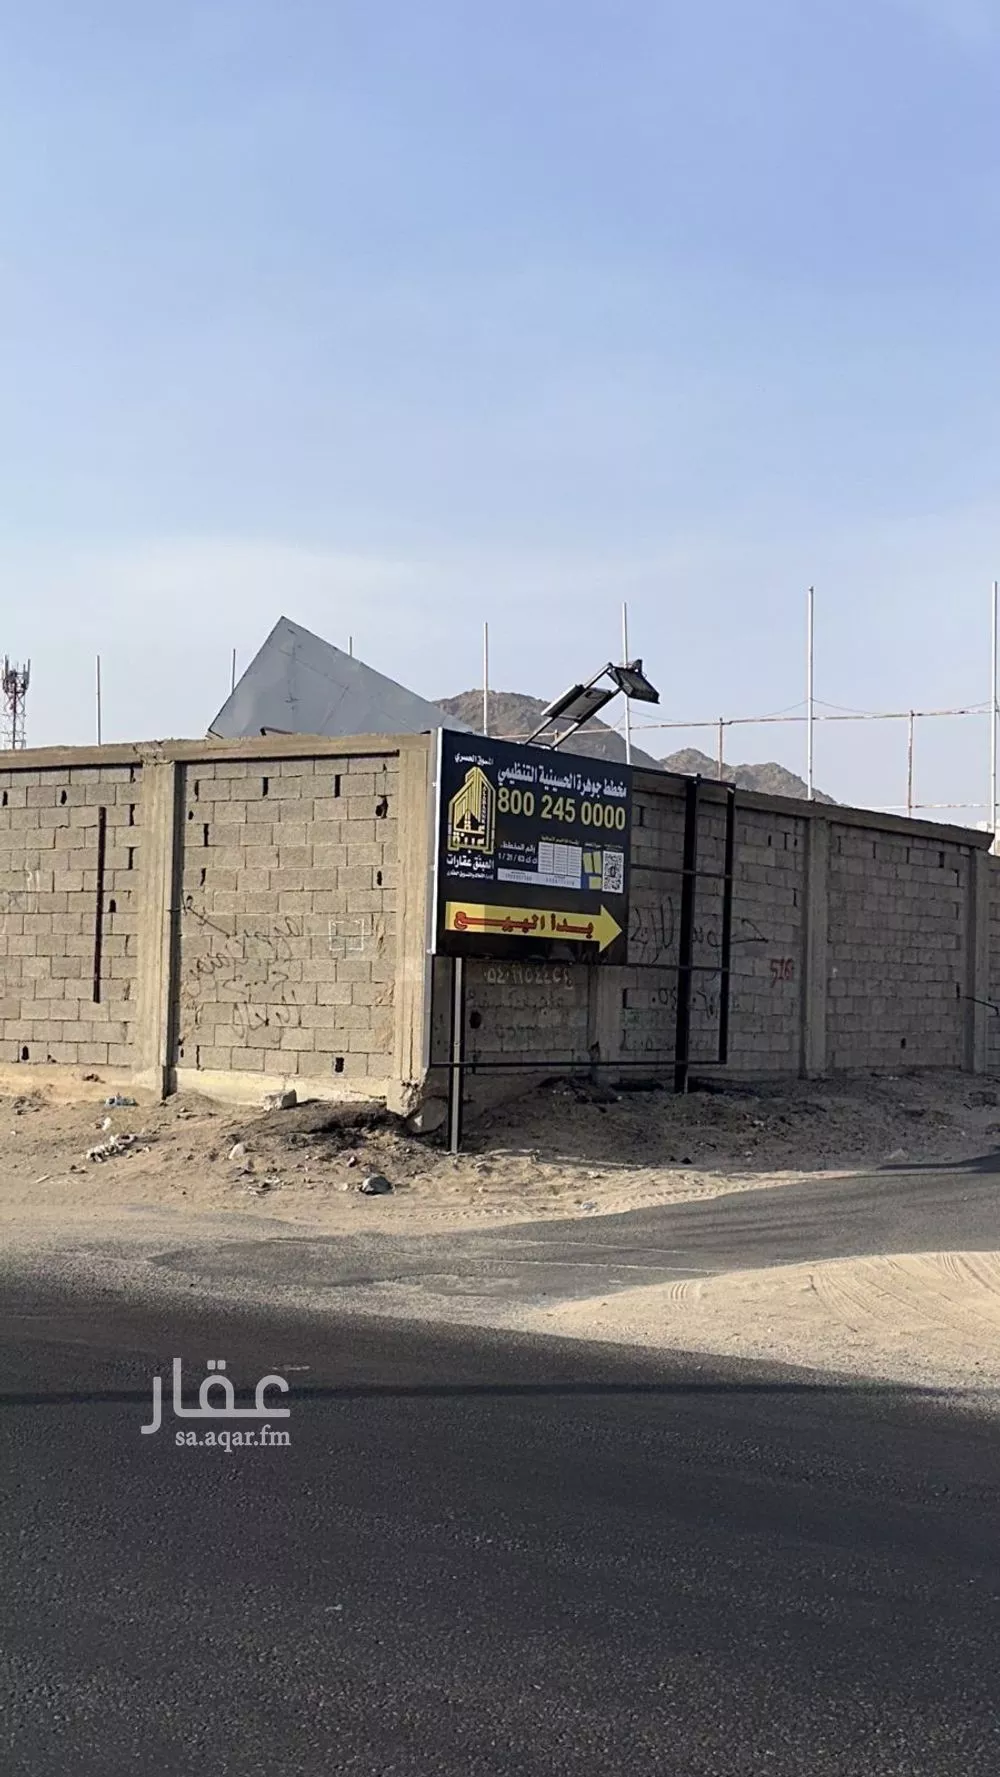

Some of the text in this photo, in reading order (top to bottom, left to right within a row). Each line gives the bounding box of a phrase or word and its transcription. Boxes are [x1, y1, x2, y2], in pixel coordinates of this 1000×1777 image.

[497, 762, 627, 798] مخطط جوهرة الحسينية التنظيمي
[497, 787, 535, 817] 800
[541, 795, 576, 823] 245
[581, 801, 626, 830] 0000
[446, 853, 472, 868] عقارات
[454, 911, 594, 939] بدأ البيع
